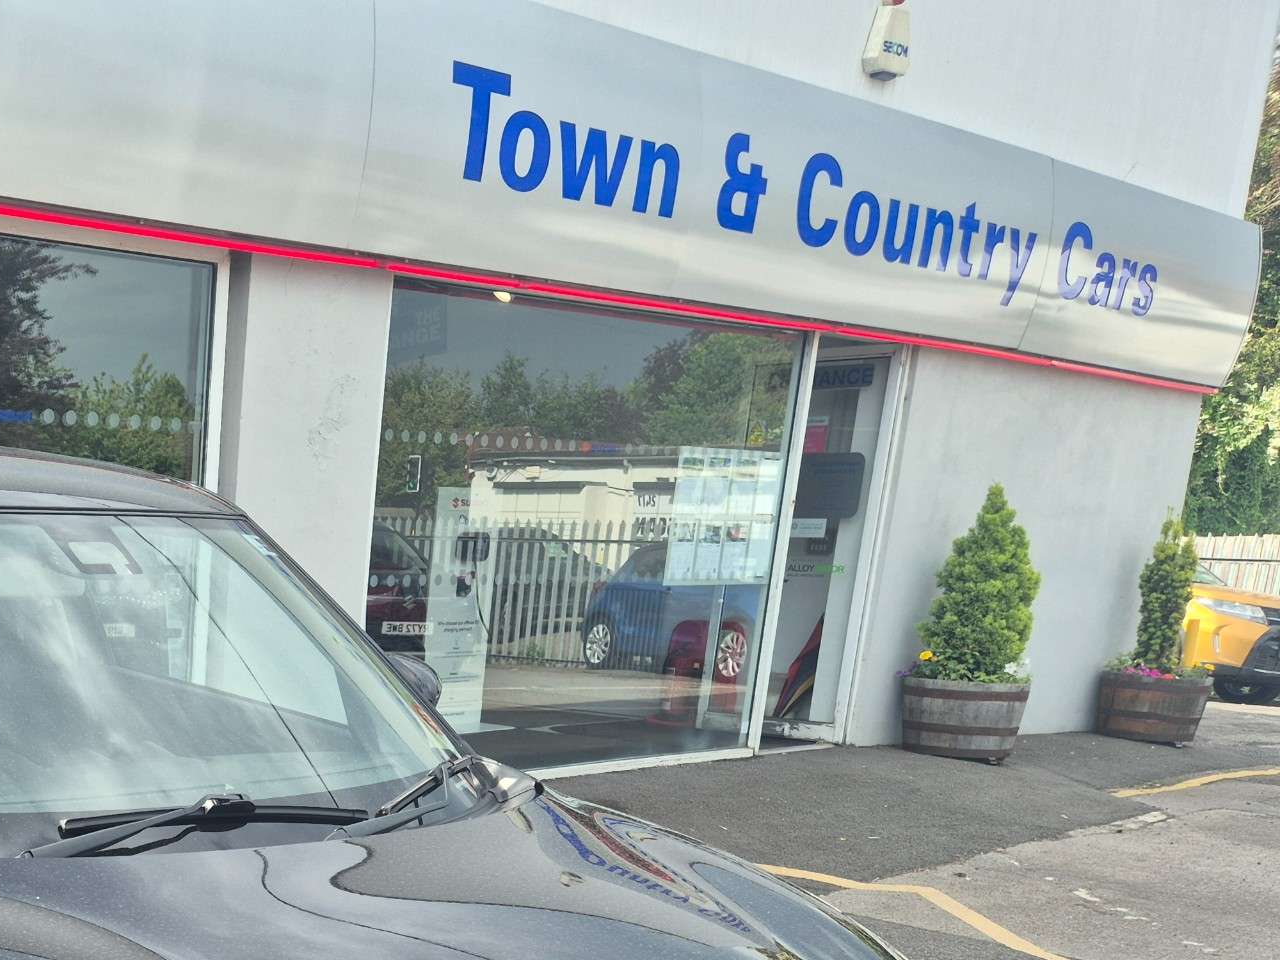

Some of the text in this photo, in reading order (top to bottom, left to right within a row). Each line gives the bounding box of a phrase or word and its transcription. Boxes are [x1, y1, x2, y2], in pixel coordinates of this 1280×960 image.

[452, 60, 1158, 317] Town & Country Cars
